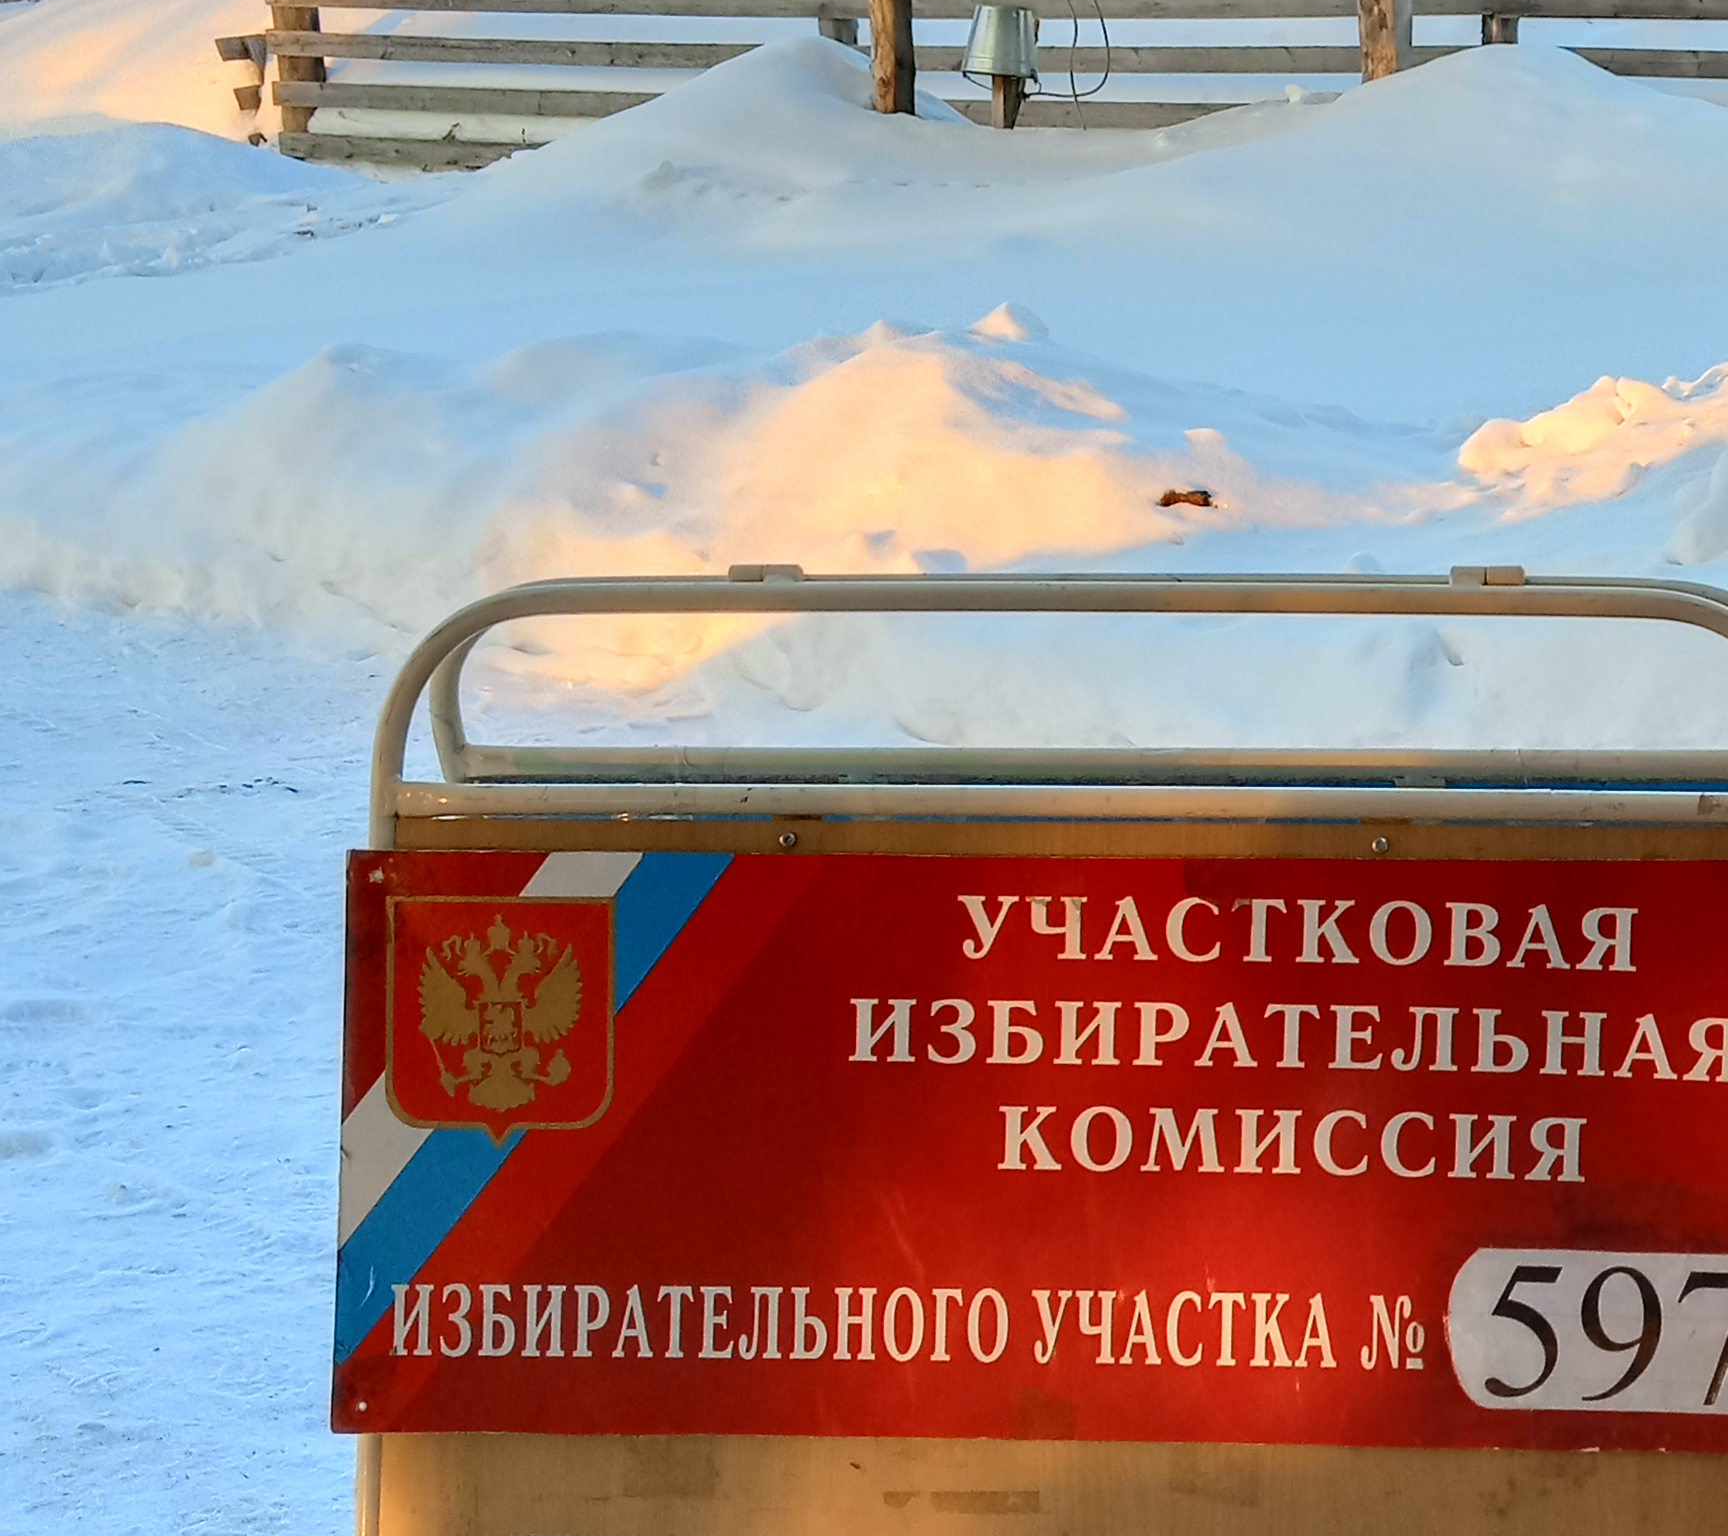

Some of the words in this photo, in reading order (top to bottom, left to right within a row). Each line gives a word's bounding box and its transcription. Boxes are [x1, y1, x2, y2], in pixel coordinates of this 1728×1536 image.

[958, 893, 1640, 975] УЧАСТКОВАЯ
[996, 1103, 1589, 1185] КОМИССИЯ
[390, 1281, 1009, 1366] ИЗБИРАТЕЛЬНОГО
[1031, 1284, 1339, 1371] УЧАСТКА
[1359, 1295, 1428, 1372] №
